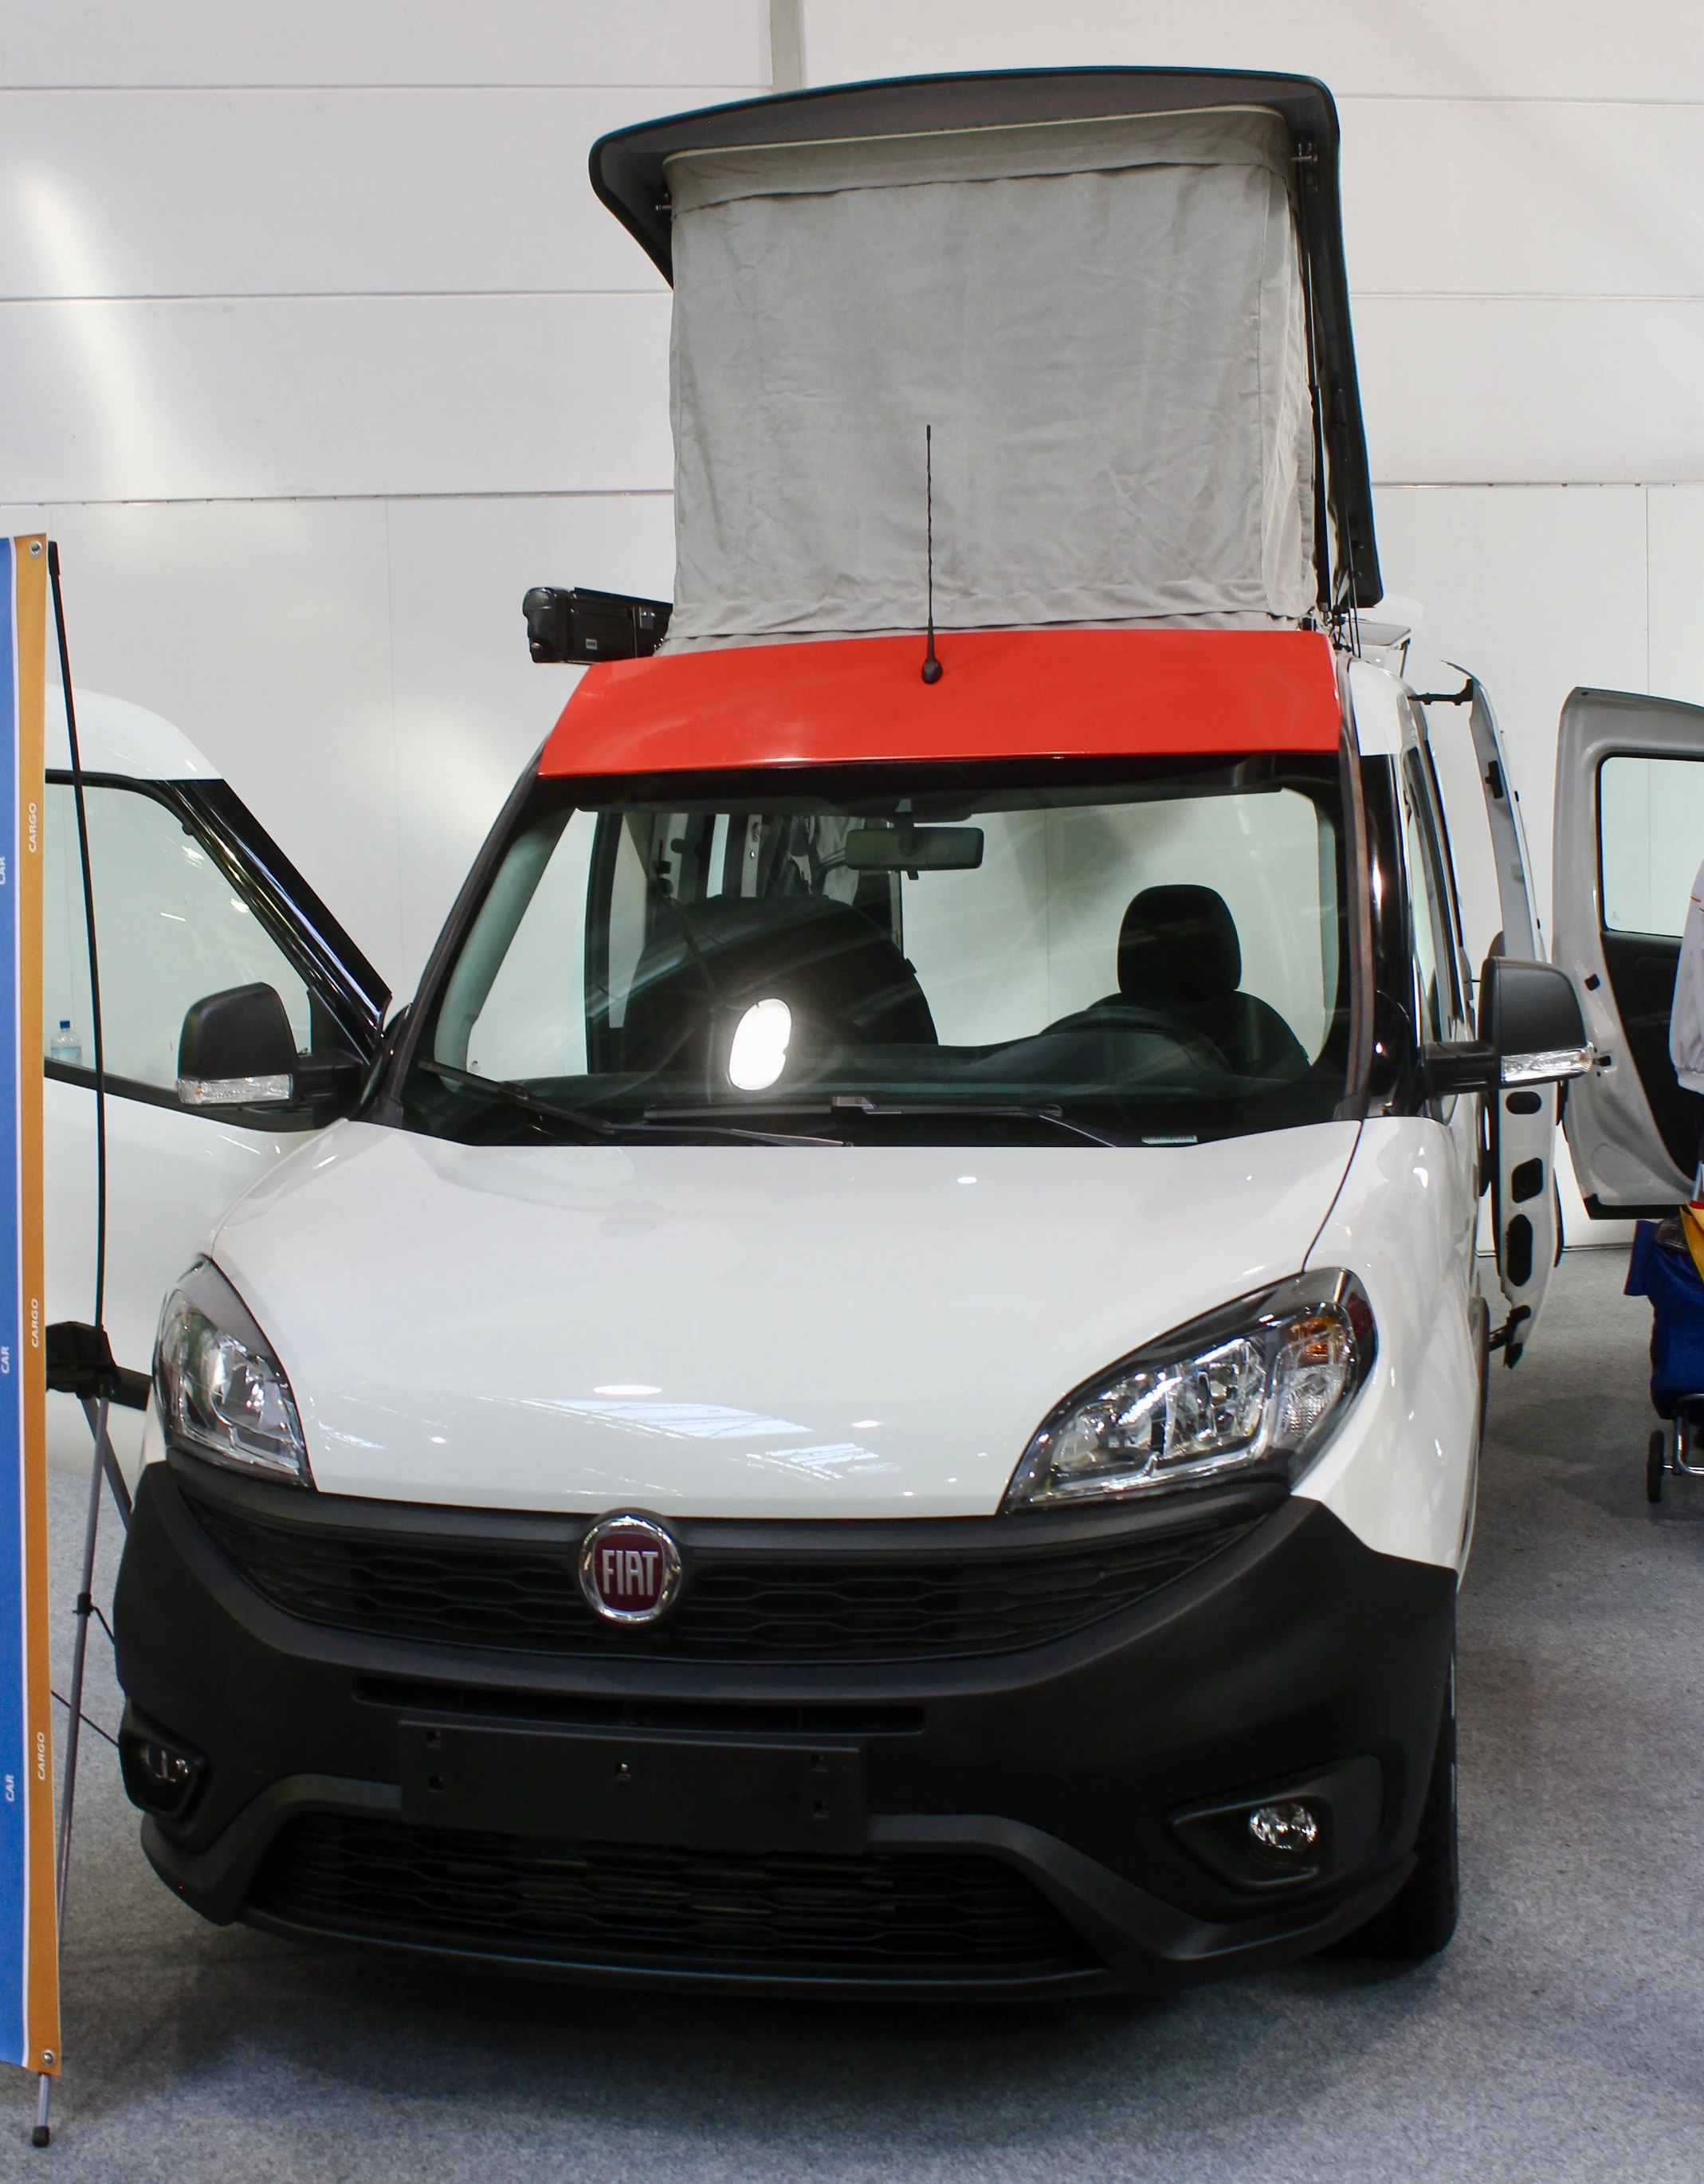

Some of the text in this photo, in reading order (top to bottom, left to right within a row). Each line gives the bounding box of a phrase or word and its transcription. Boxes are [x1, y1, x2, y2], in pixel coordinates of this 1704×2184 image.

[1, 1345, 10, 1374] CAR
[602, 1549, 658, 1596] FIAT
[37, 1731, 46, 1781] CARGO
[5, 1774, 14, 1802] CAR
